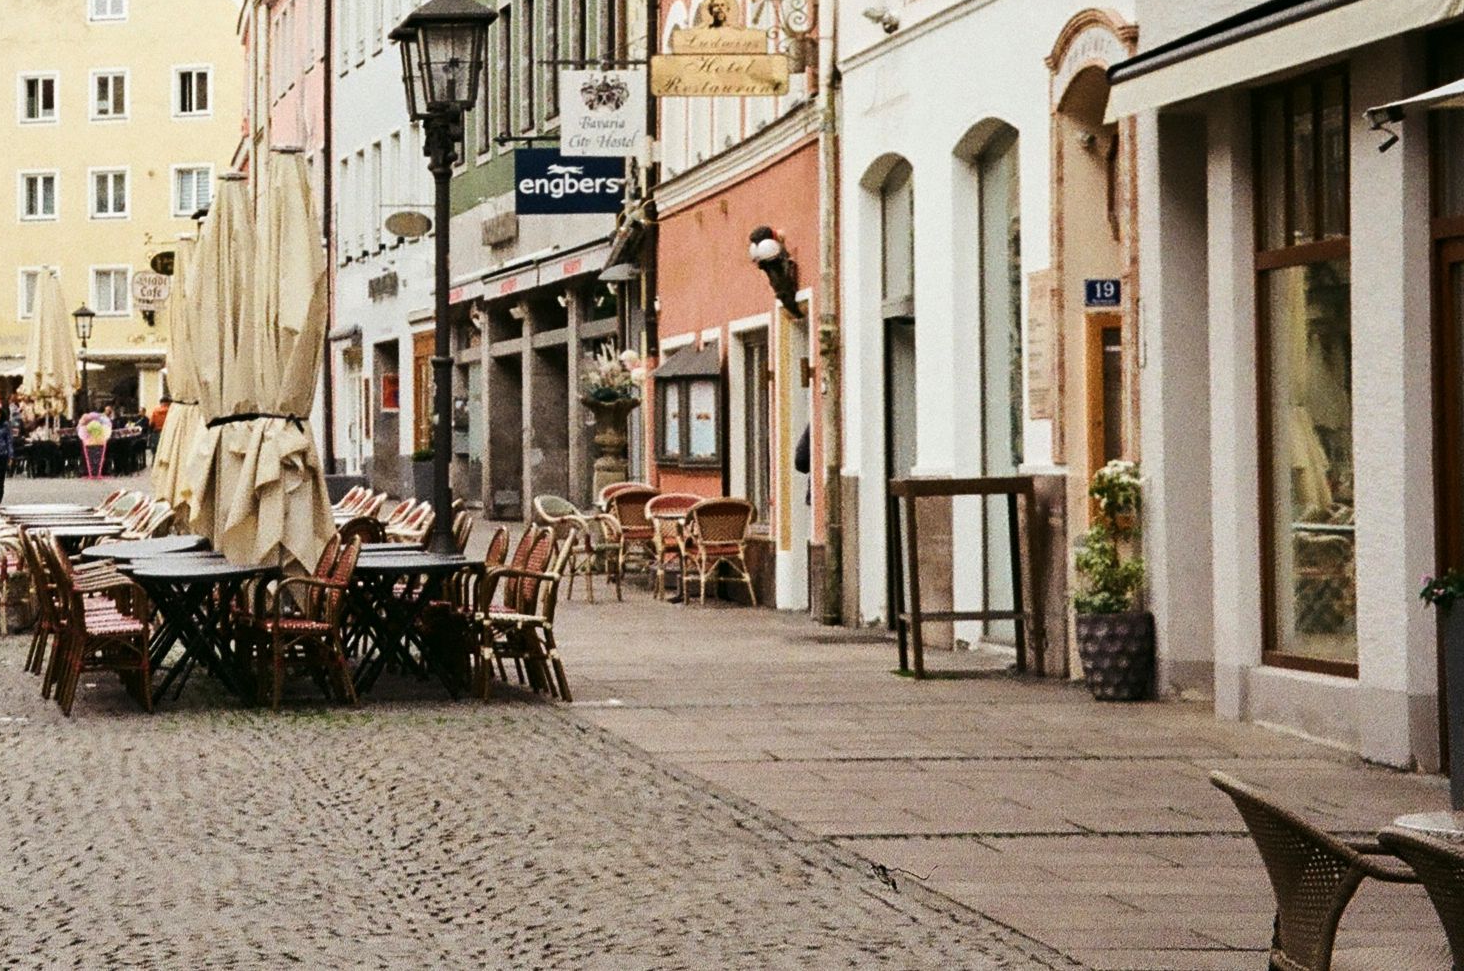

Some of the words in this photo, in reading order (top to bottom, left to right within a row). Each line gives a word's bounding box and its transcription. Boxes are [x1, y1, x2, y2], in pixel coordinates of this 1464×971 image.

[688, 56, 755, 73] Hotel
[657, 75, 783, 94] Restaurant
[578, 116, 626, 129] Bavaria
[569, 135, 593, 153] City
[596, 129, 639, 149] Hostel
[519, 173, 620, 199] engbers
[1095, 280, 1115, 298] 19
